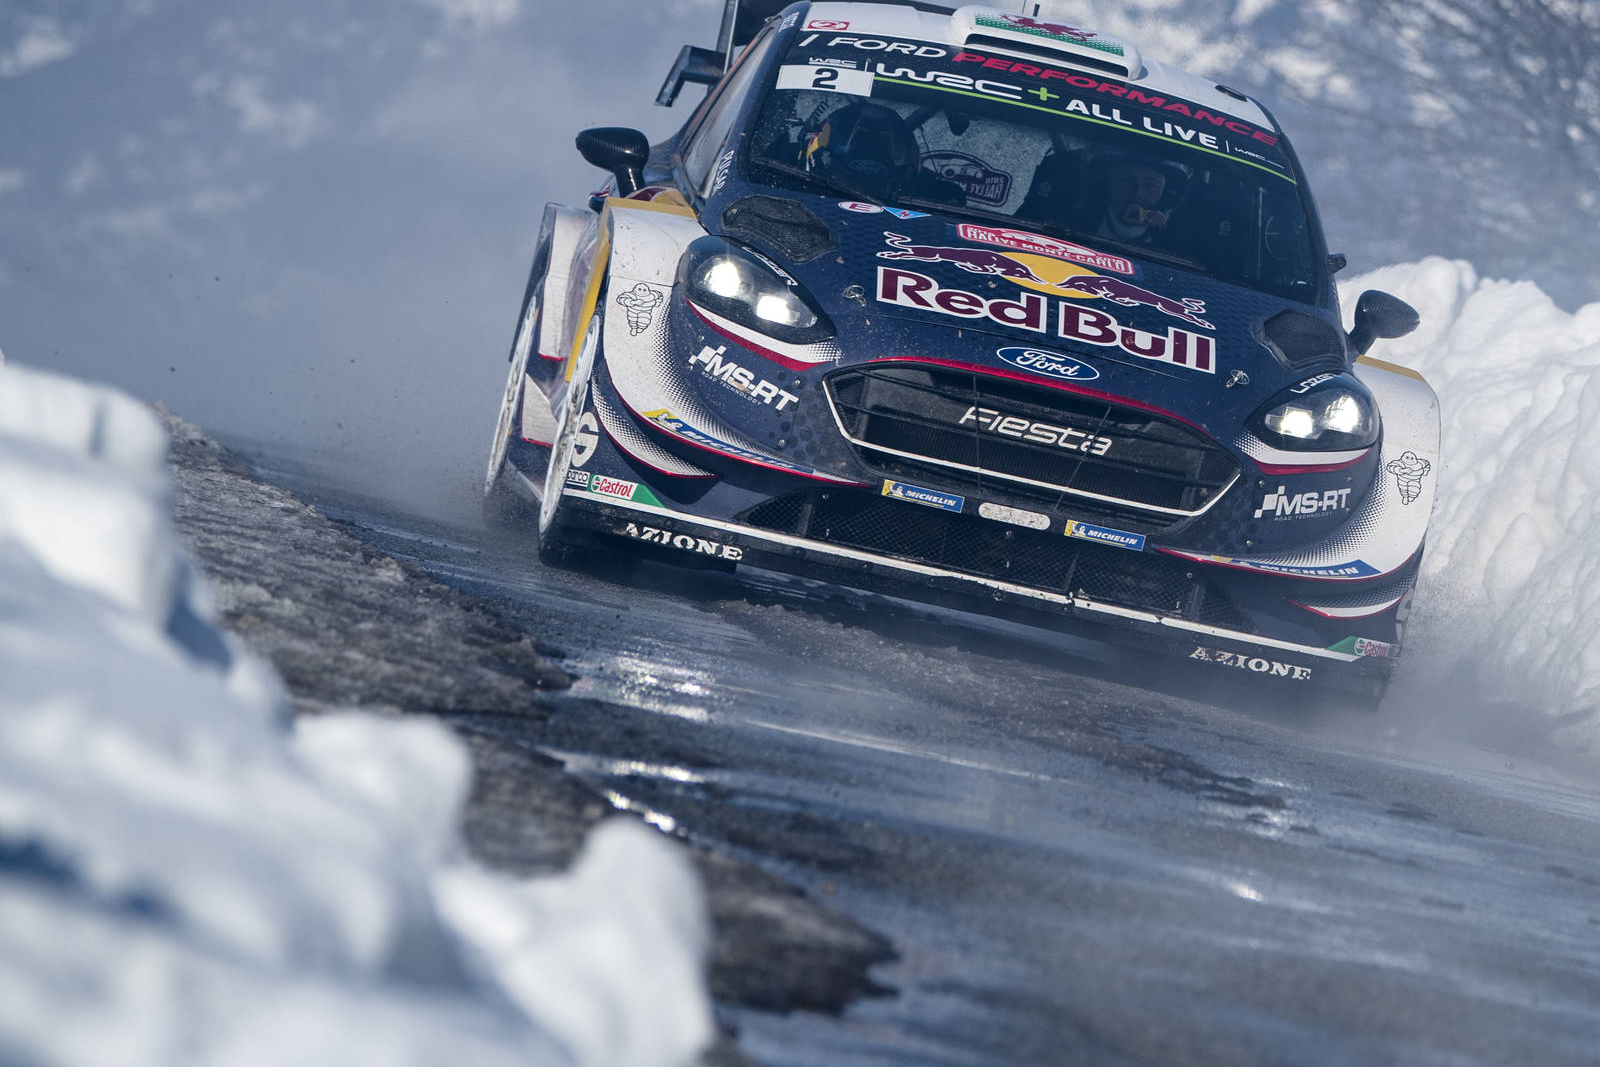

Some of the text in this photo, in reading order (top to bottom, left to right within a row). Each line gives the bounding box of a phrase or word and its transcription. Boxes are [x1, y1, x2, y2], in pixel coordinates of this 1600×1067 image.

[812, 67, 838, 90] 2
[827, 36, 1279, 146] FORD PERFORMANCE
[1066, 99, 1132, 125] ALL
[1143, 116, 1219, 149] LIVE
[877, 267, 1216, 374] Red Bull
[1016, 350, 1082, 377] Ford
[959, 407, 1112, 456] Fiesta
[600, 478, 633, 497] Castrol
[906, 490, 957, 508] MICHELIN
[625, 522, 744, 561] AZIONE
[1088, 528, 1138, 545] MICHELIN
[1260, 565, 1359, 577] MICHELIN
[1189, 646, 1311, 680] AZIONE
